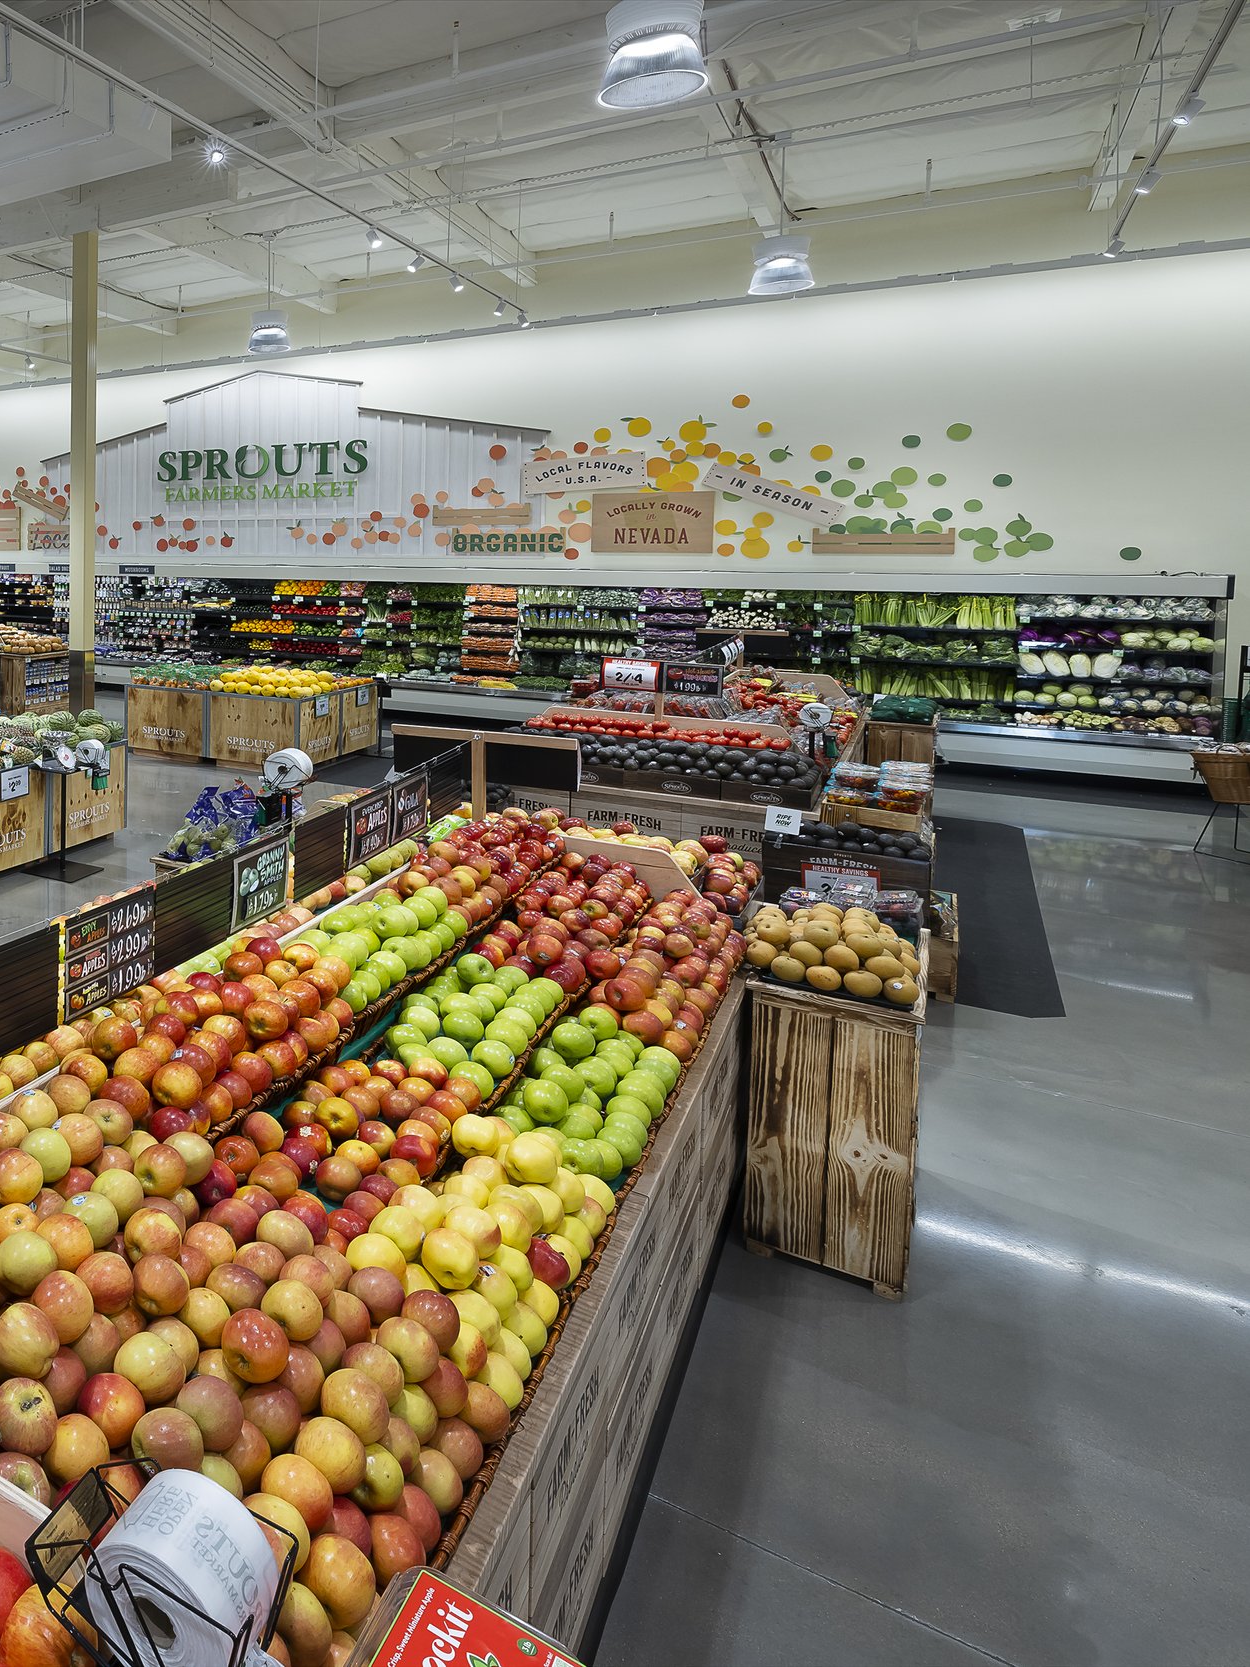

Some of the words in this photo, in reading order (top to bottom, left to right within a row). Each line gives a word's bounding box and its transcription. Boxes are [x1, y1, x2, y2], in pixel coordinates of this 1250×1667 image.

[157, 439, 368, 481] SPROUTS
[535, 464, 573, 483] LOCAL
[578, 461, 634, 475] FLAVORS
[566, 475, 601, 485] U.S.A.
[165, 484, 257, 502] FARMERS
[262, 480, 358, 500] MARKET
[730, 477, 747, 489] IN
[752, 485, 813, 511] SEASON
[606, 502, 656, 518] LOCALLY
[660, 502, 702, 519] GROWN
[646, 513, 657, 521] in
[453, 533, 564, 552] ORGANIC
[613, 528, 689, 545] NEVADA
[142, 725, 186, 739] SPROUTS
[349, 724, 370, 737] SPROUTS
[226, 736, 275, 751] SPROUTS
[308, 736, 332, 750] SPROUTS
[68, 801, 110, 824] SPROUTS
[367, 806, 387, 832] APPLES
[587, 810, 662, 832] FARM-FRESH
[775, 813, 792, 821] RIPE
[774, 819, 792, 827] NOW
[700, 826, 764, 843] FARM-FRE
[256, 846, 286, 870] GRANNY
[260, 862, 285, 882] SMITH
[263, 872, 283, 887] APPLES
[812, 865, 840, 873] HEALTHY
[841, 868, 869, 877] SAVINGS
[81, 920, 97, 937] ENVY
[81, 952, 106, 978] APPLES
[86, 985, 107, 1006] APPLES
[547, 1365, 600, 1522] FARM-FRESH
[396, 1630, 410, 1652] Sweet
[405, 1603, 426, 1634] Miniature
[422, 1587, 436, 1606] Apple
